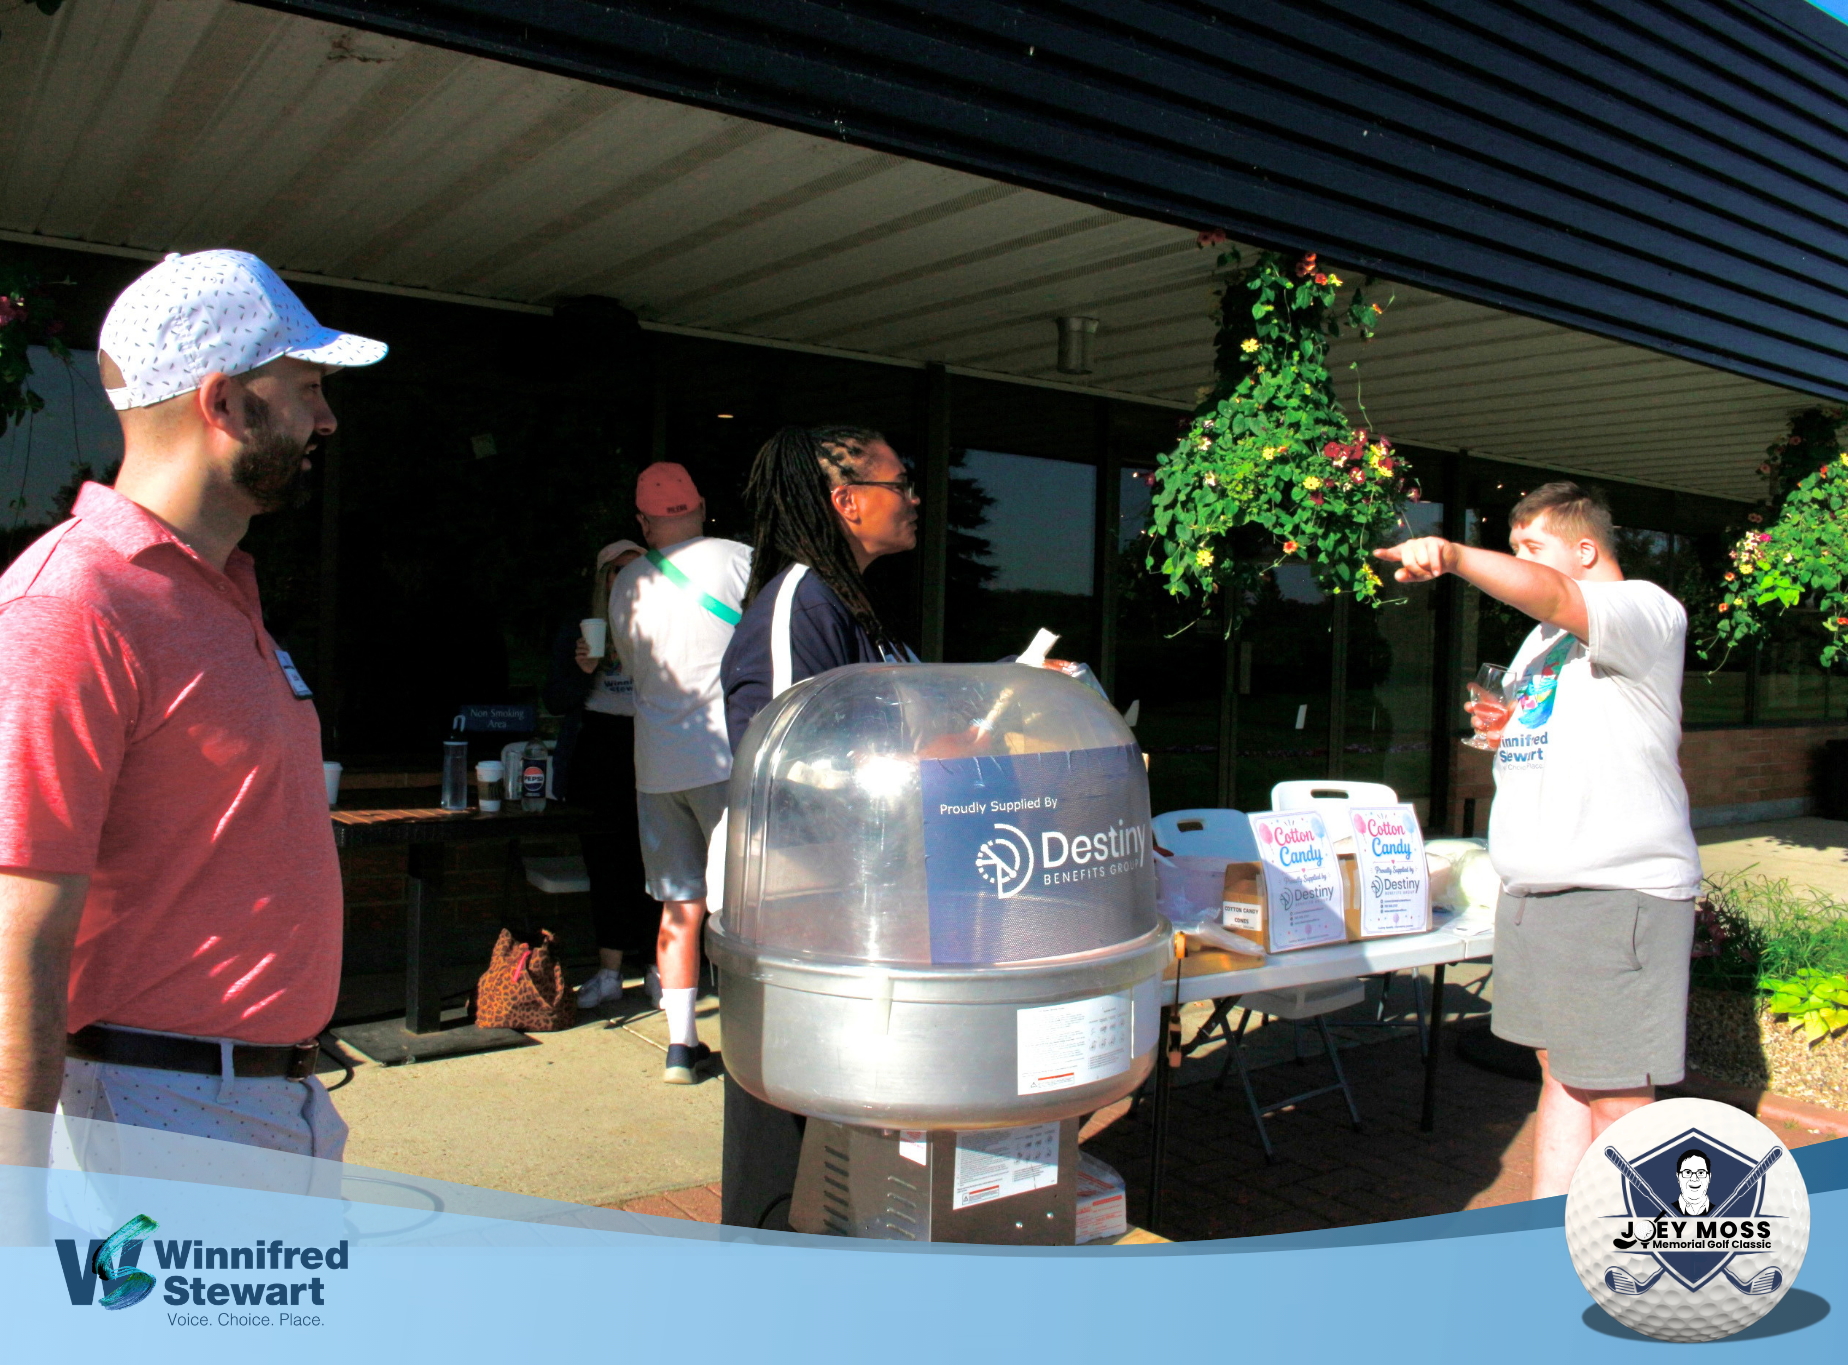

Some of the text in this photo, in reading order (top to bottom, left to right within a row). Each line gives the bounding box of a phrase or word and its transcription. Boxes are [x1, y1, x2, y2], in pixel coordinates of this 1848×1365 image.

[470, 708, 525, 721] Non Smoking
[487, 719, 507, 728] Area
[940, 797, 1058, 815] Proudly Supplied By
[1274, 827, 1315, 847] Cotton
[1367, 818, 1406, 838] Cotton
[1041, 818, 1146, 869] Destiny
[1371, 837, 1412, 860] Candy
[1279, 845, 1324, 867] Candy
[1043, 858, 1139, 886] BENEFITS GROUP
[1294, 884, 1334, 901] Destiny
[1383, 876, 1420, 894] Destiny
